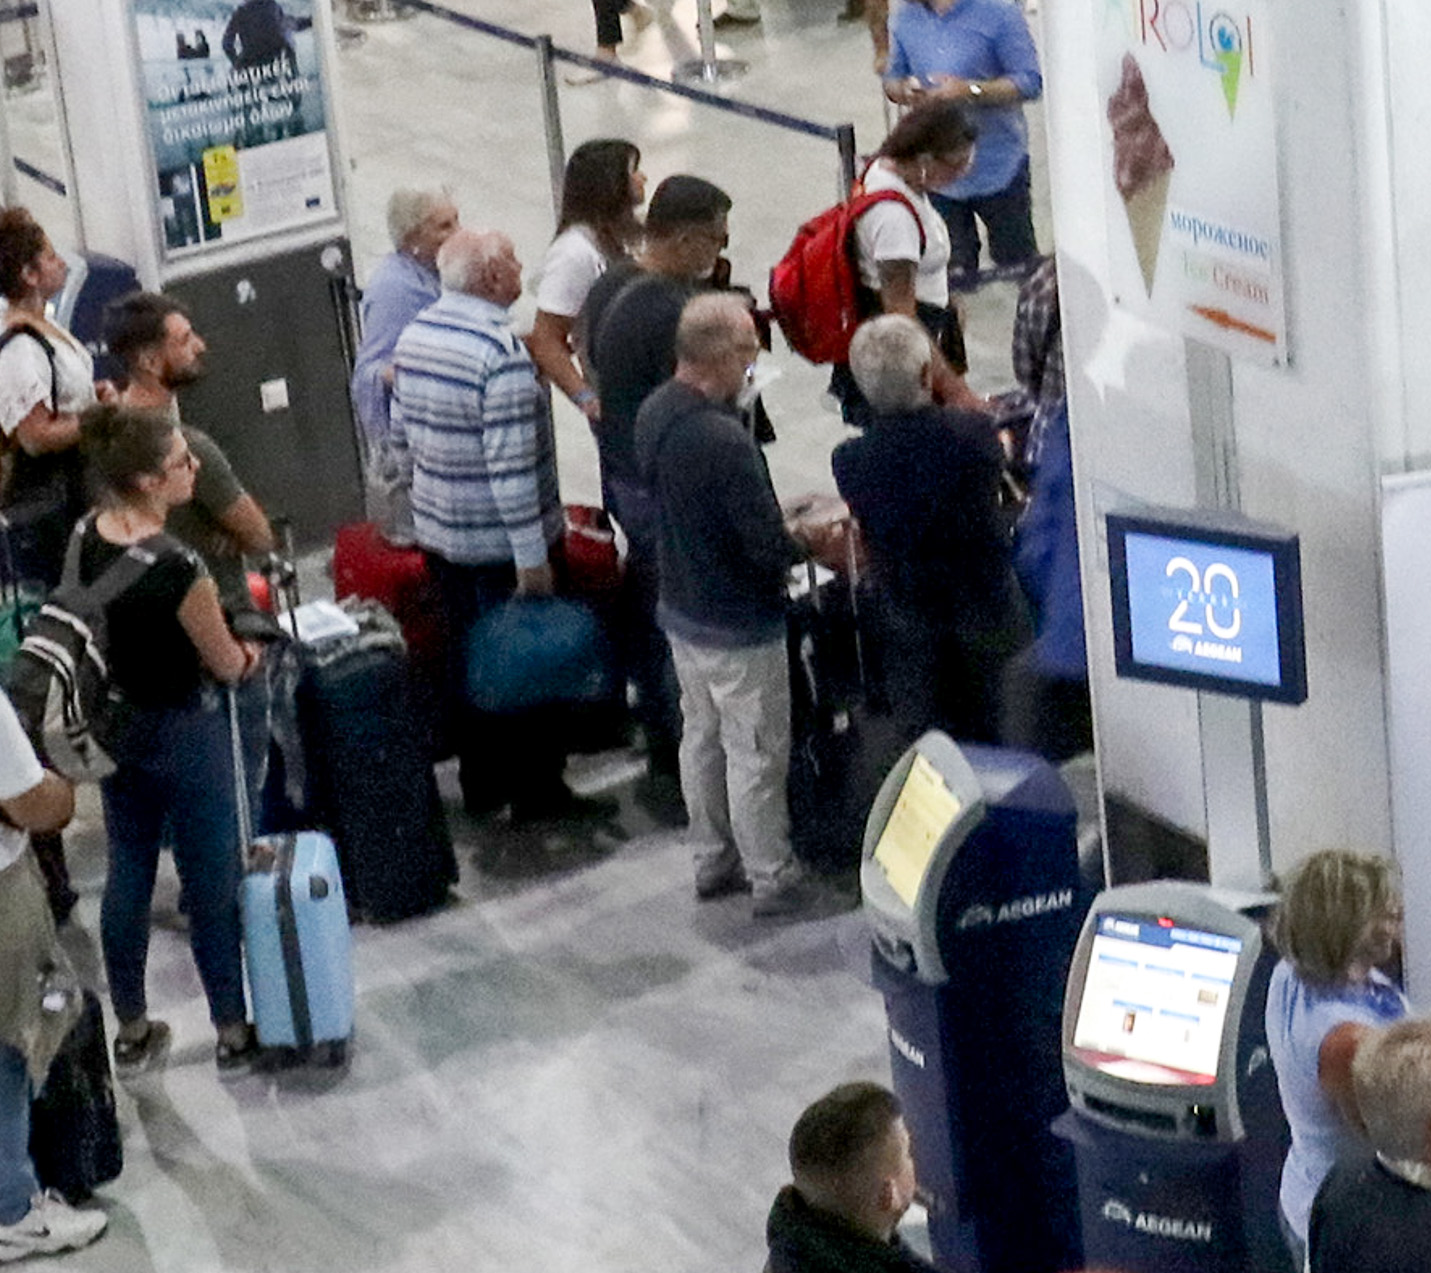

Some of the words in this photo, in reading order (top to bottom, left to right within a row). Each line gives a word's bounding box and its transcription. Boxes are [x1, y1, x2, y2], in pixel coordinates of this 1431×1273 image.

[1212, 262, 1269, 303] Cream
[1165, 557, 1241, 640] 20
[1194, 640, 1242, 664] AEGEAN
[996, 888, 1073, 924] AEGEAN
[1135, 1212, 1212, 1243] AEGEAN
